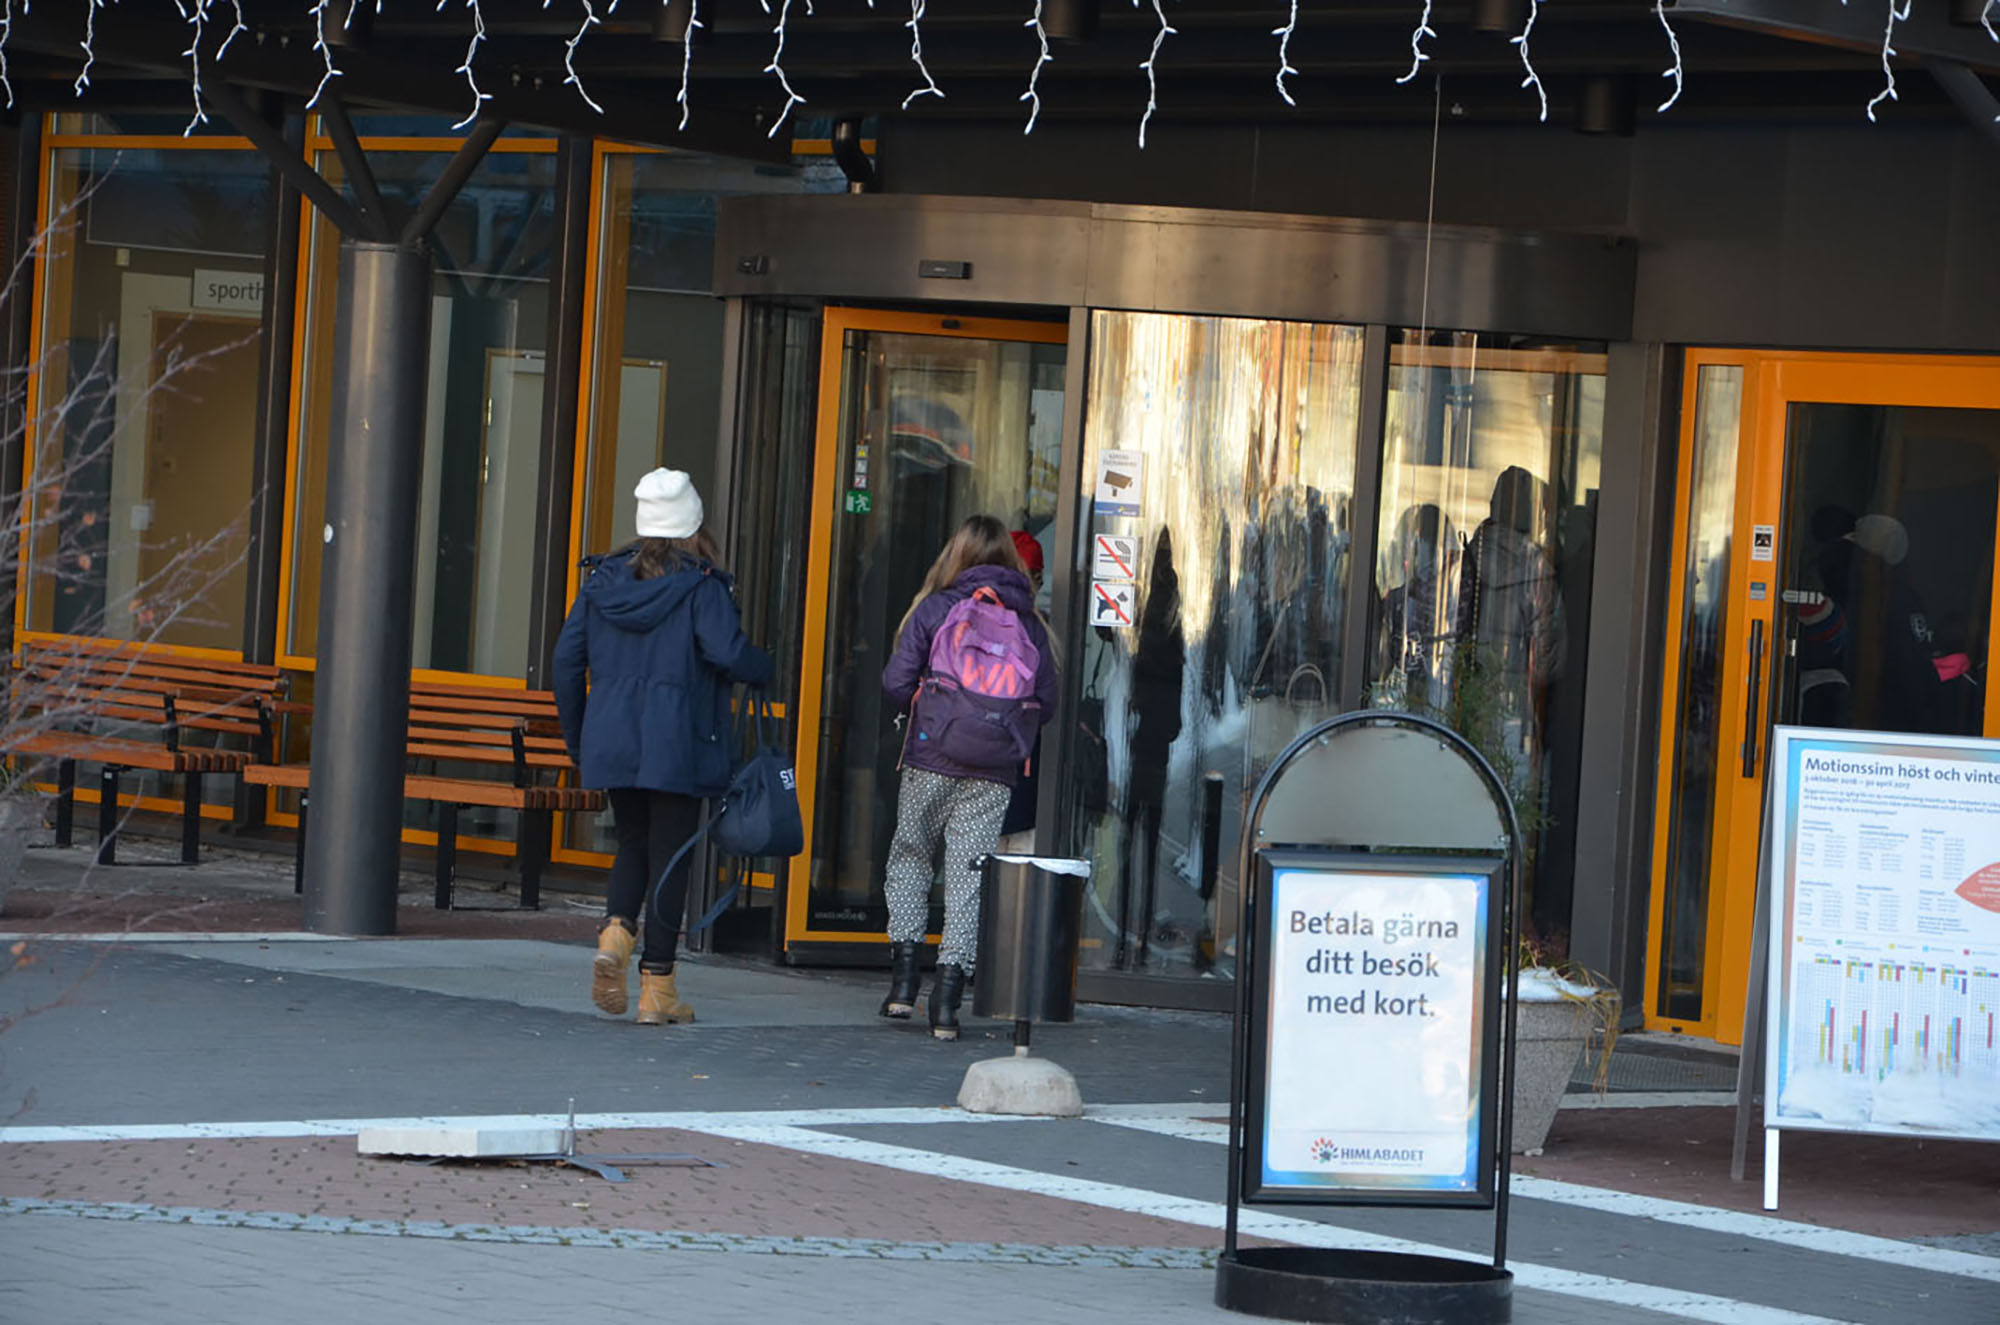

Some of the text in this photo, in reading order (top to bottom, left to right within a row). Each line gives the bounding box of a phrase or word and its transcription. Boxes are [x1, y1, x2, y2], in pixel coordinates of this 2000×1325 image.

[1805, 757, 2000, 784] Motionssim höst och vinte
[1290, 910, 1459, 945] Betala gärna
[1306, 948, 1440, 978] ditt besök
[1307, 989, 1435, 1017] med kort.
[1341, 1147, 1424, 1161] HIMLABADET
